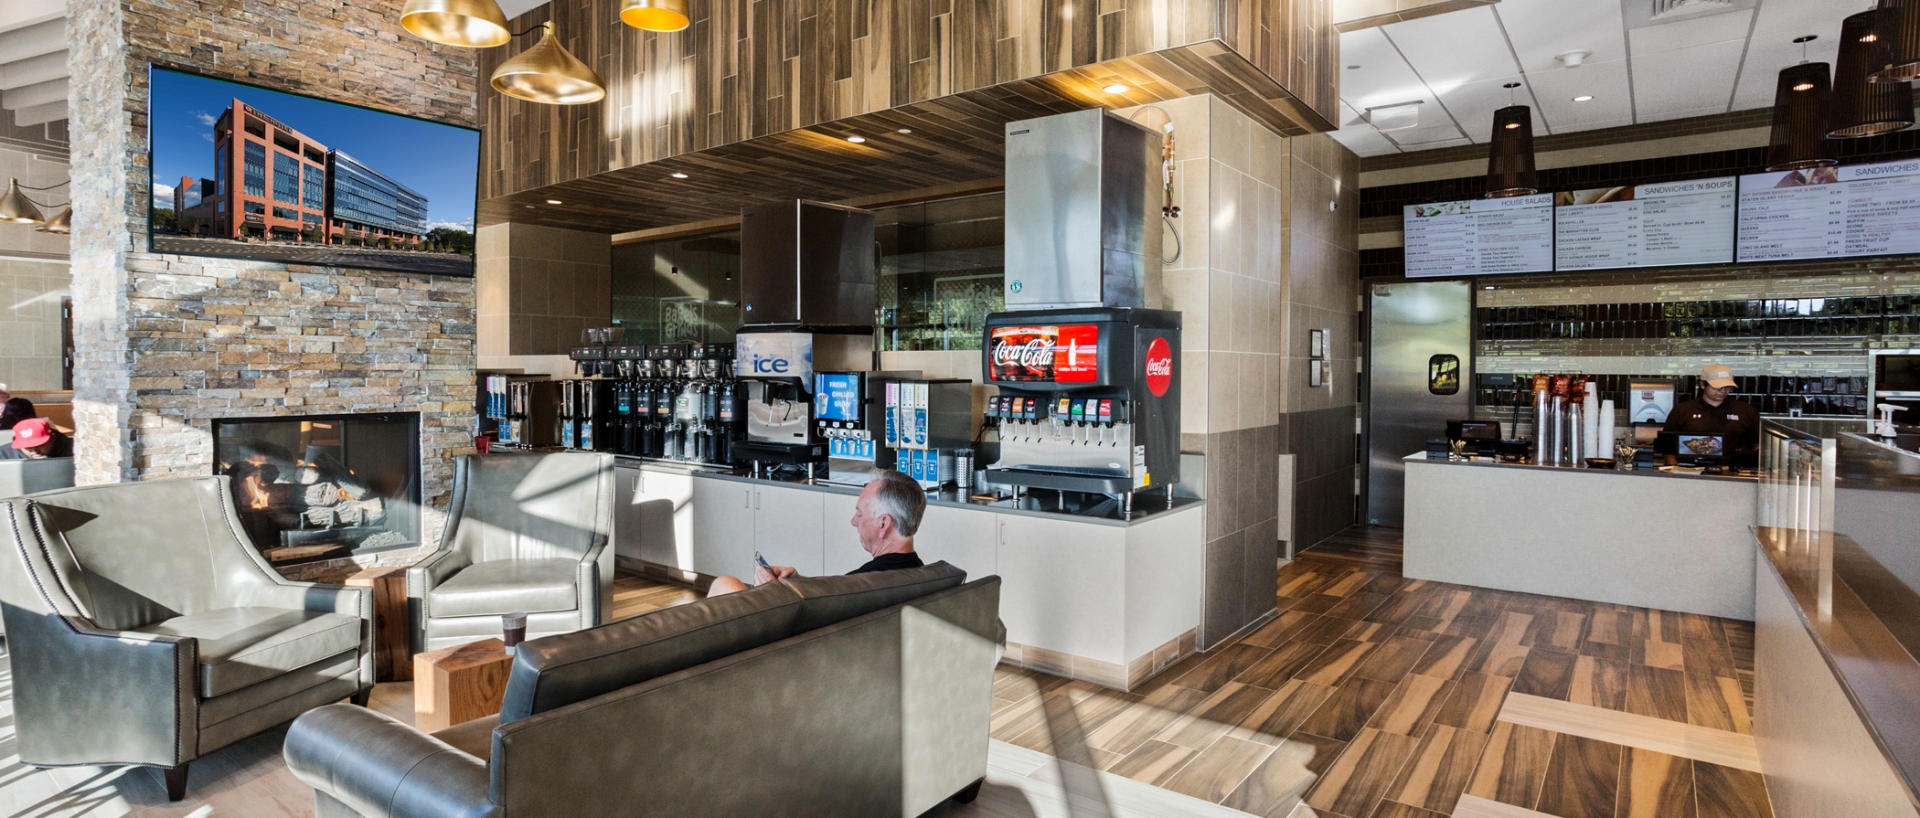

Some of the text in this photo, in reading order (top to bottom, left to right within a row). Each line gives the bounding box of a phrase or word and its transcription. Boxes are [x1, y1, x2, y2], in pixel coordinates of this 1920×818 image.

[1855, 163, 1918, 176] SANDWICHES
[1644, 184, 1694, 195] SANDWICHES
[1705, 181, 1732, 189] SOUPS
[994, 338, 1056, 366] Coca-Cola
[754, 354, 788, 373] ice
[1146, 358, 1172, 376] Coca-Cola
